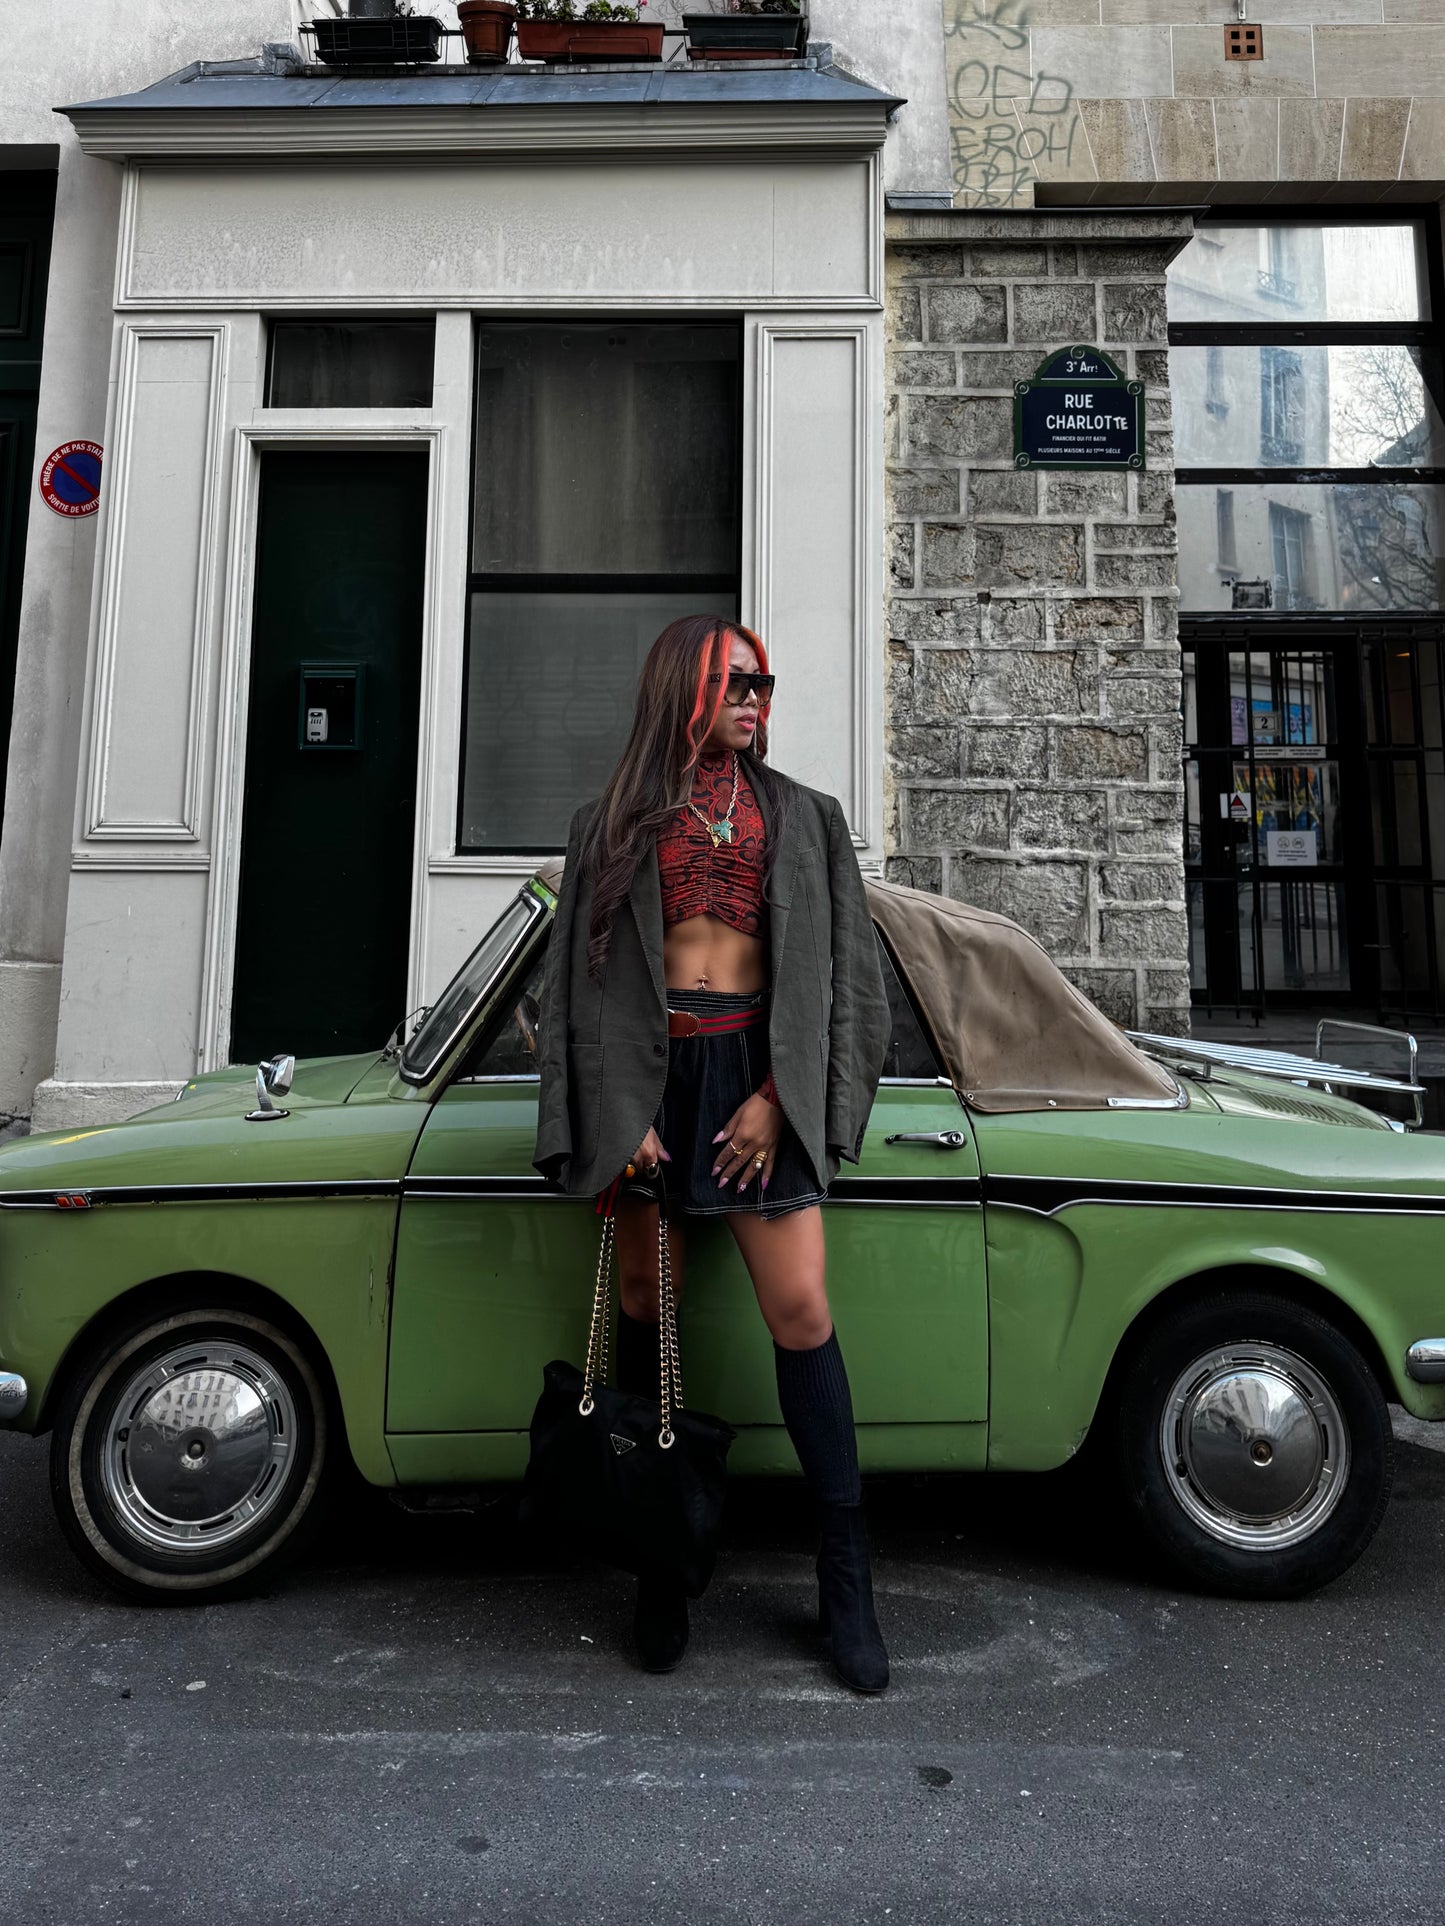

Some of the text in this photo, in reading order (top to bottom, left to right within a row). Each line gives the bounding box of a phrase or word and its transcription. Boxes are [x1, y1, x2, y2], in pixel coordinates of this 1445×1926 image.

[1064, 394, 1094, 409] RUE
[1046, 414, 1128, 430] CHARLOTTE
[52, 452, 62, 463] DE
[60, 447, 71, 455] NE
[48, 494, 69, 512] SORTIE
[70, 505, 80, 513] DE
[1261, 716, 1269, 729] 2
